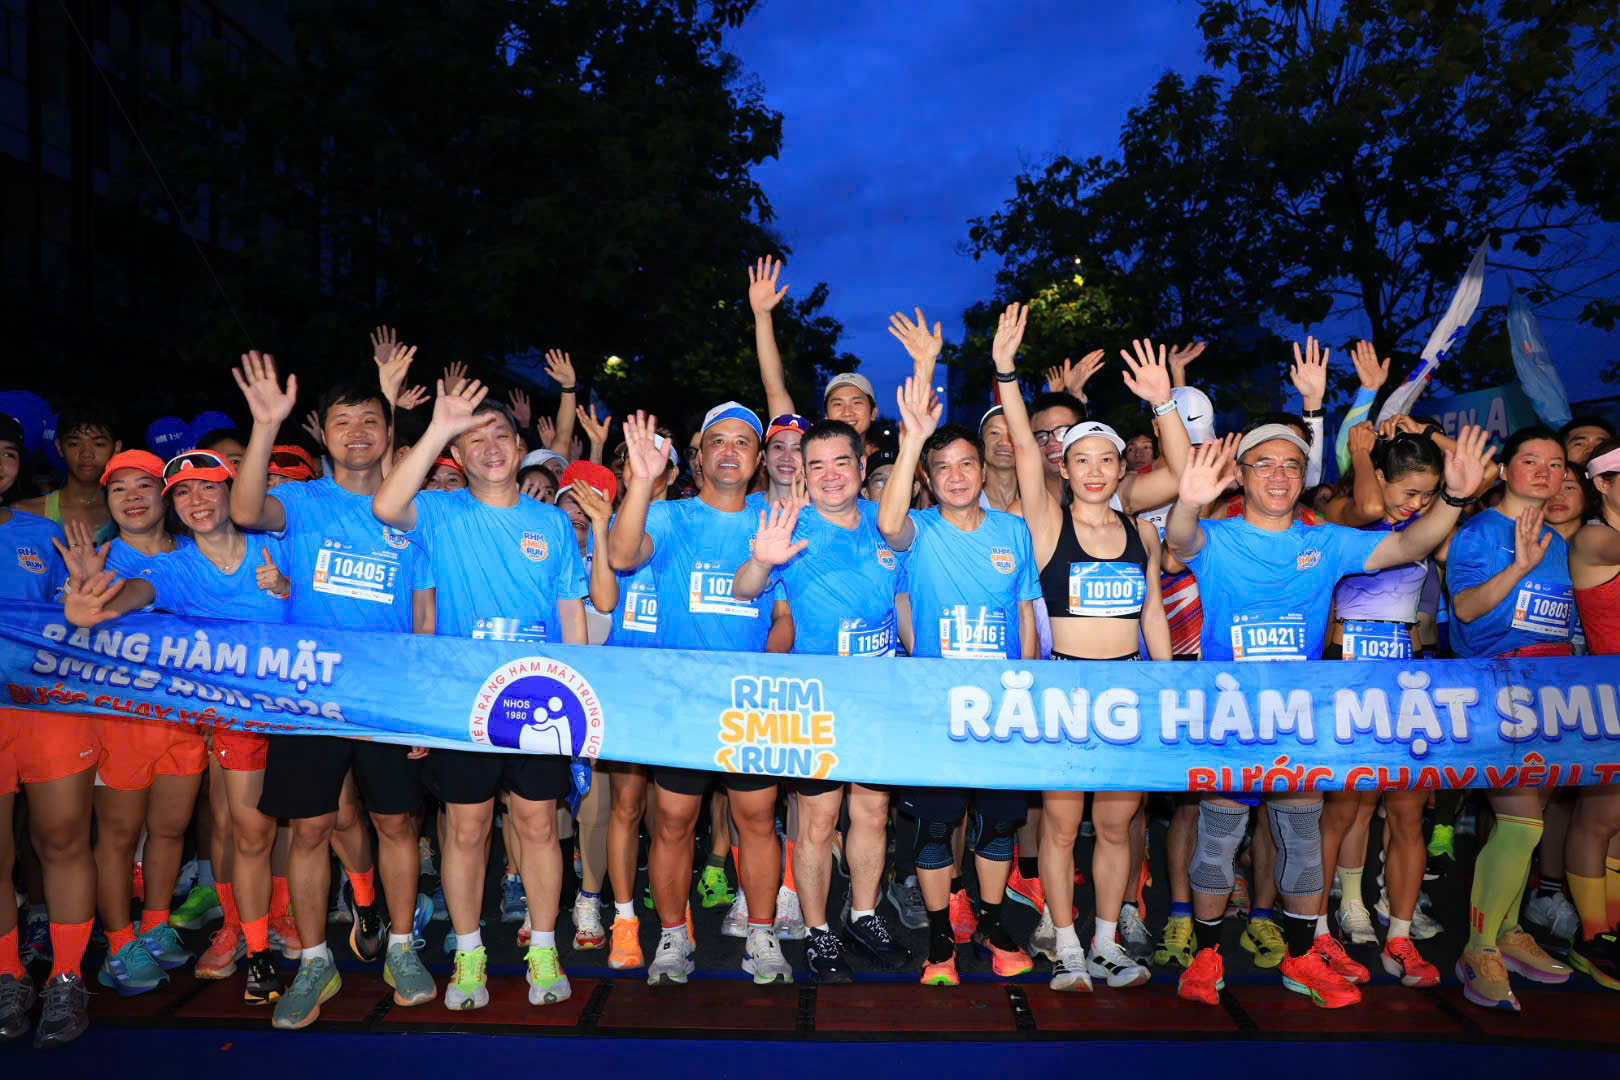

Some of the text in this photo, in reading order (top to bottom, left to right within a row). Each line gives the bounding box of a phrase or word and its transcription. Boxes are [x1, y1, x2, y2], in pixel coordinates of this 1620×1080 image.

[1486, 397, 1509, 440] A
[523, 532, 544, 542] RHM
[526, 547, 544, 556] RUN
[334, 557, 386, 583] 10405
[708, 576, 734, 596] 107
[1086, 581, 1133, 599] 10100
[640, 598, 657, 616] 10
[1533, 598, 1569, 619] 10803
[955, 624, 997, 643] 10416
[1247, 627, 1296, 646] 10421
[1360, 639, 1404, 659] 10321
[157, 630, 249, 677] HÀM
[256, 640, 343, 692] MẶT
[503, 699, 530, 709] NHOS
[732, 676, 823, 712] RHM
[576, 682, 601, 728] TRUNG
[948, 670, 1140, 743] RĂNG
[1158, 672, 1314, 743] HÀM
[1334, 671, 1479, 758] MẶT
[505, 711, 528, 720] 1980
[719, 709, 835, 746] SMILE
[740, 746, 813, 776] RUN
[1594, 763, 1620, 787] T
